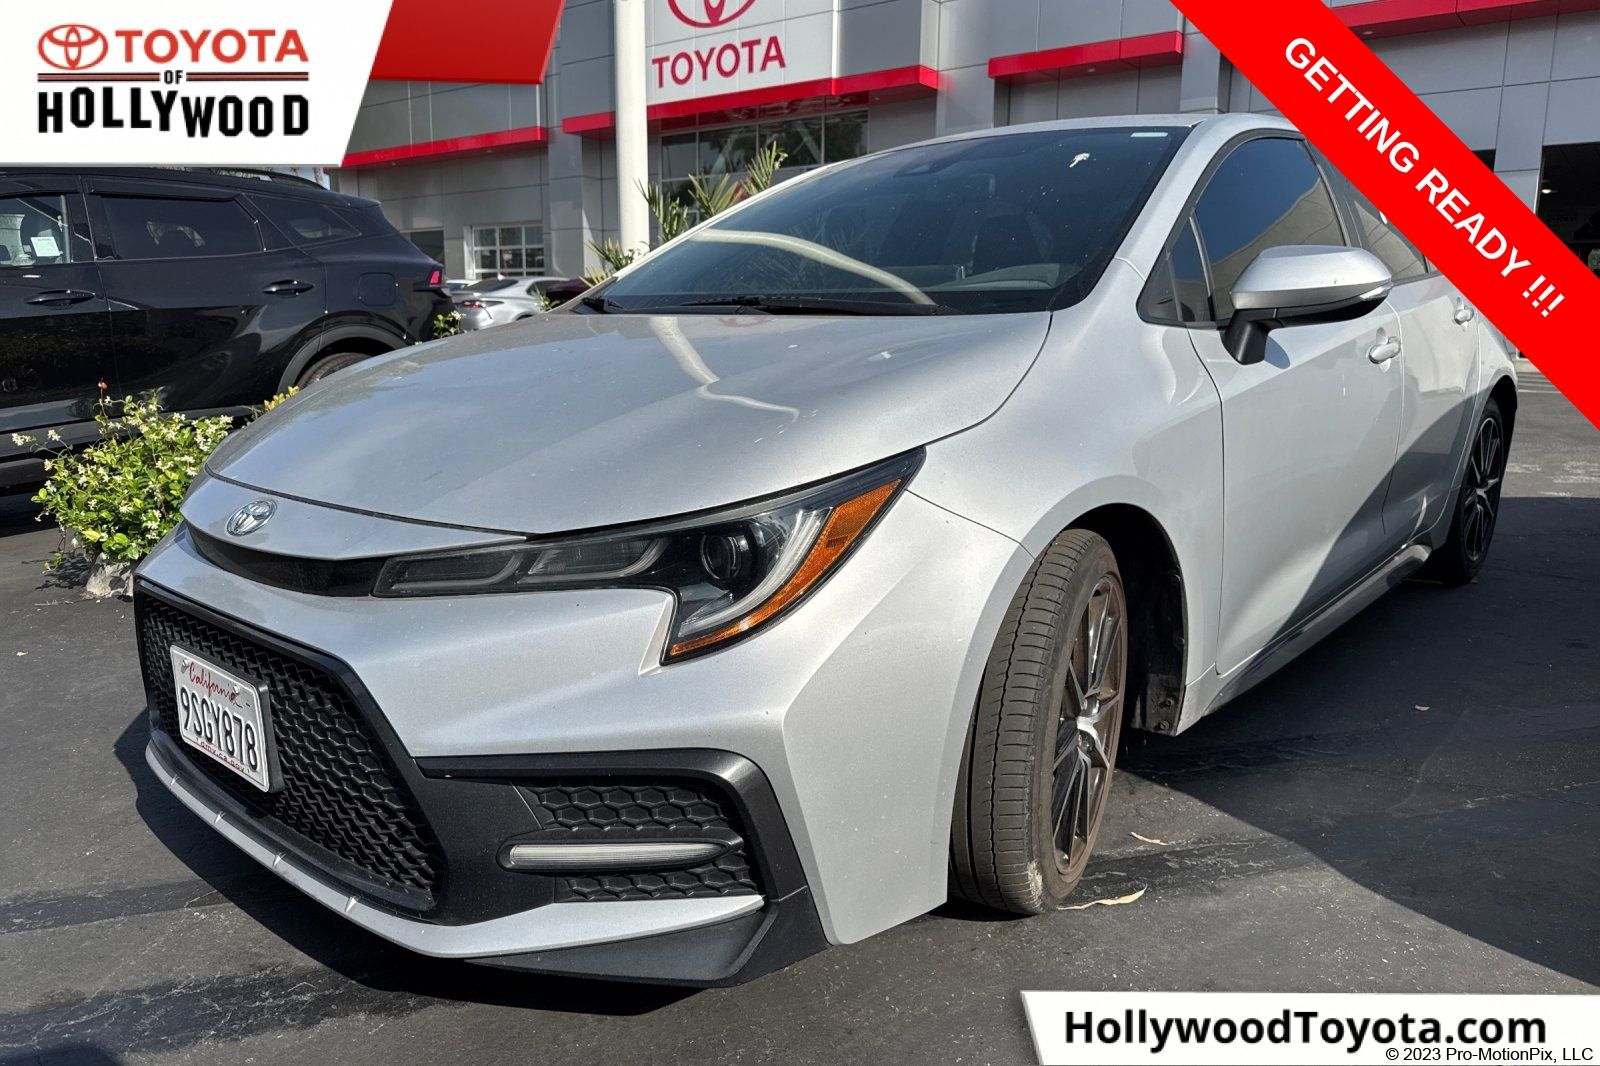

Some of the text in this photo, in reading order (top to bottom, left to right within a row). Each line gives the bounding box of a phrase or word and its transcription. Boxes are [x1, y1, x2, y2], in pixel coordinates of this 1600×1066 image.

[652, 35, 786, 89] TOYOTA
[189, 661, 239, 701] California
[180, 686, 258, 772] 9SGY878
